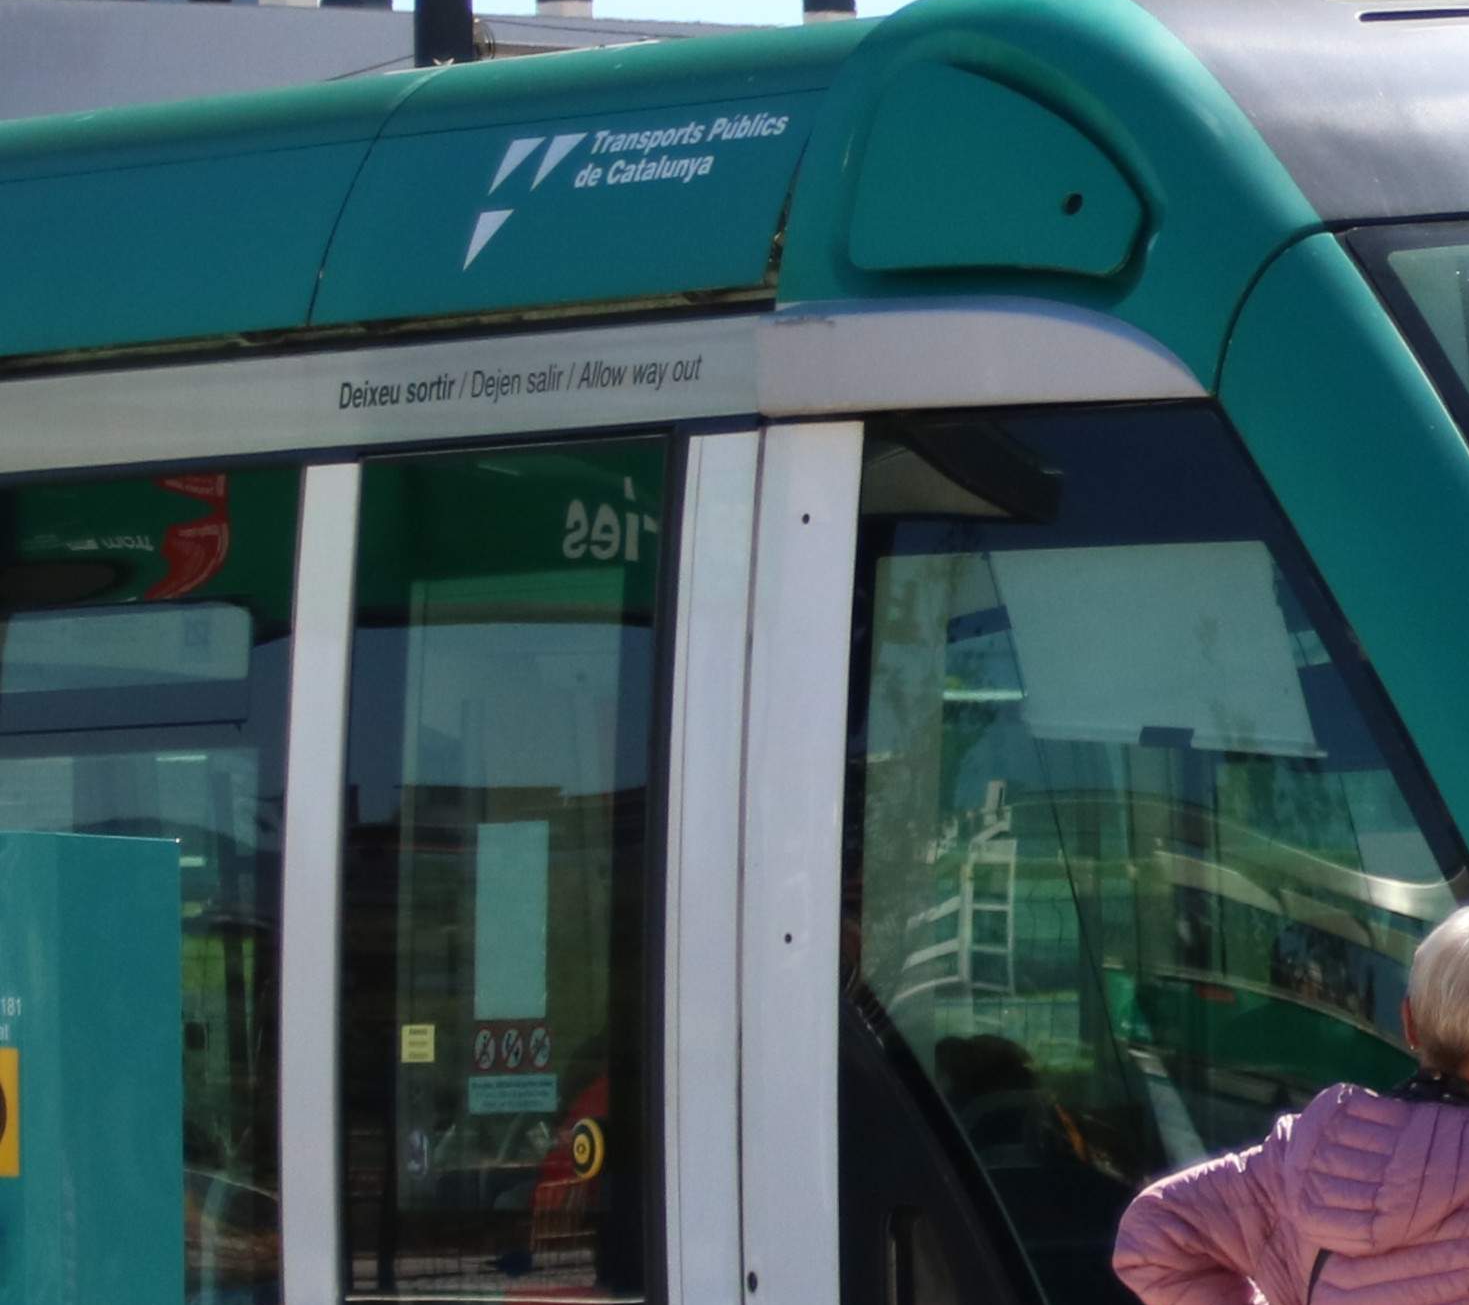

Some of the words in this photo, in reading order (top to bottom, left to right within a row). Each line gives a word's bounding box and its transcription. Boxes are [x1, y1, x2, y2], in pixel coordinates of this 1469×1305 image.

[590, 121, 702, 156] Transports
[706, 112, 789, 143] Públics
[574, 163, 603, 189] de
[606, 154, 715, 185] Catalunya
[339, 381, 400, 410] Deixeu
[405, 372, 456, 403] sortir
[470, 368, 521, 405] Dejen
[527, 363, 565, 395] salir
[577, 360, 627, 391] Allow
[632, 363, 668, 391] way
[672, 355, 704, 382] out
